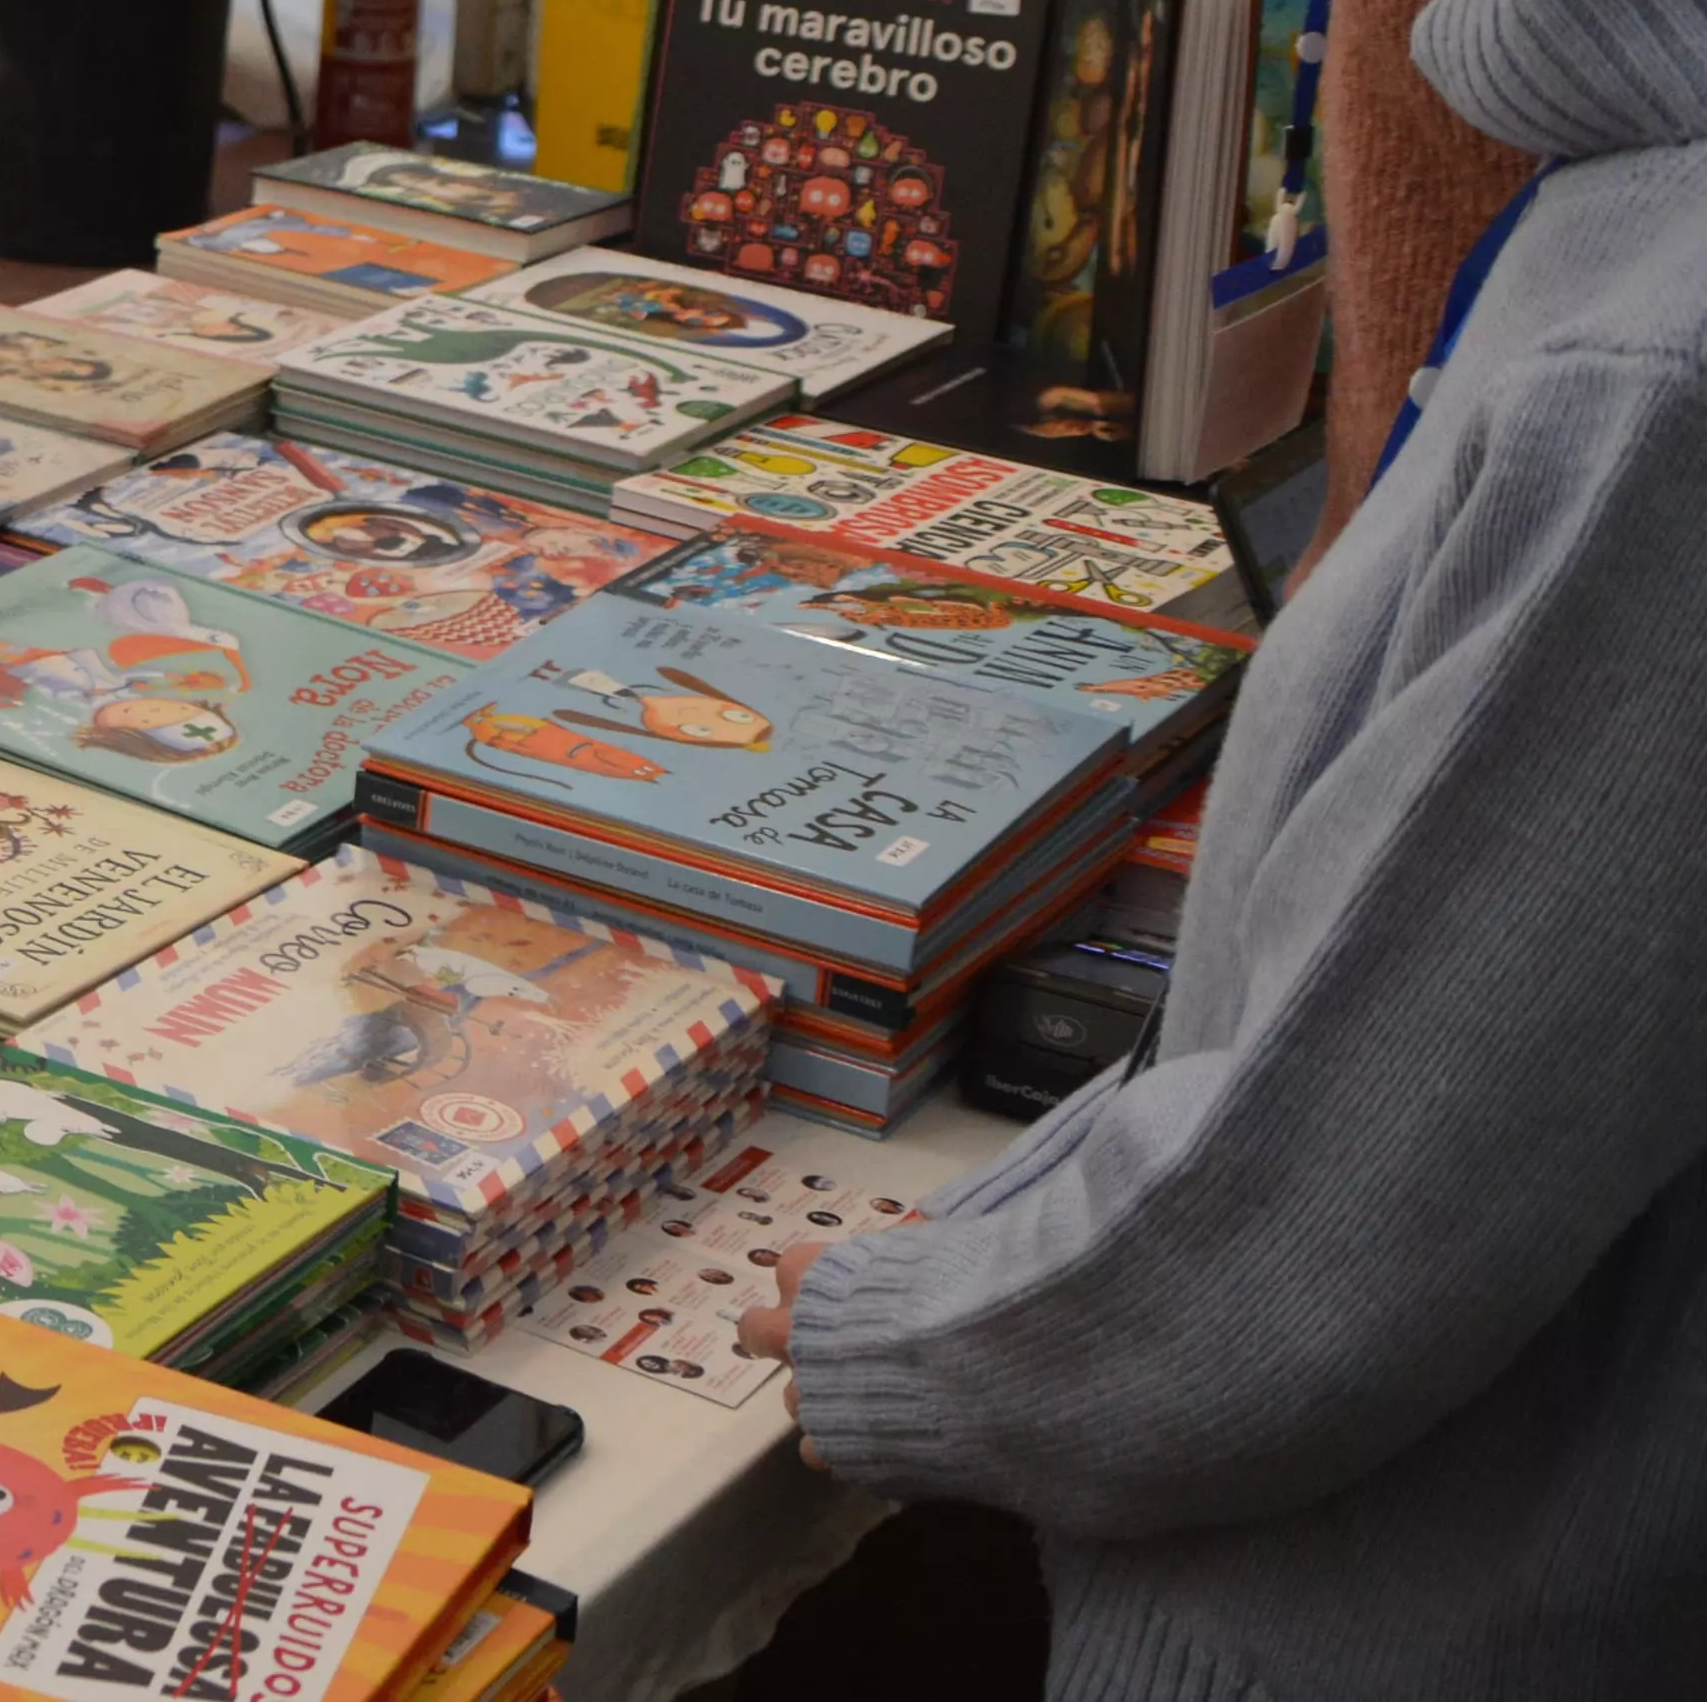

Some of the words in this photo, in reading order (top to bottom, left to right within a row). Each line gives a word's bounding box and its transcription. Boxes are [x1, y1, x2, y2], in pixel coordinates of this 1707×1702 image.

[758, 2, 1018, 72] maravilloso
[754, 47, 939, 103] cerebro
[830, 459, 1021, 544] ASOMBROSA
[889, 499, 1033, 560] CIENCIA
[288, 649, 419, 710] Nora
[278, 725, 352, 796] doctora
[708, 760, 889, 829] Tomasa
[788, 789, 918, 853] CASA
[927, 797, 979, 824] LA
[80, 834, 113, 851] DE
[744, 826, 780, 846] de
[0, 848, 78, 899] MILLIE
[145, 863, 211, 895] EL
[14, 888, 149, 968] JARDÍN
[257, 898, 414, 977] Correo
[142, 968, 292, 1050] MUMIN
[251, 1452, 335, 1507] LA
[54, 1424, 259, 1690] AVENTURA
[32, 1575, 80, 1634] DRAGÓN
